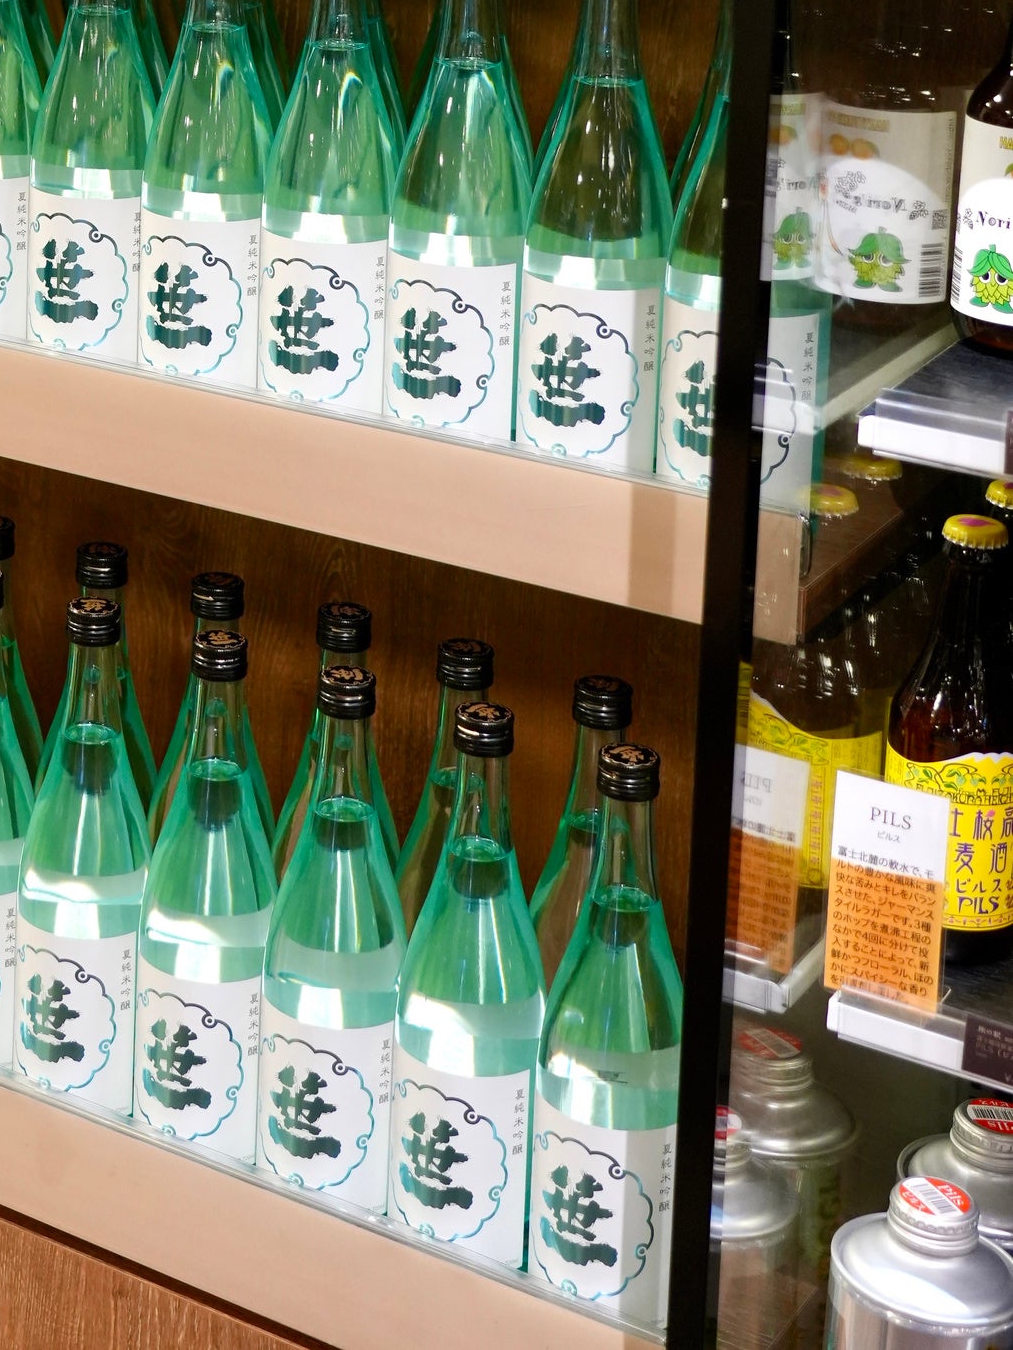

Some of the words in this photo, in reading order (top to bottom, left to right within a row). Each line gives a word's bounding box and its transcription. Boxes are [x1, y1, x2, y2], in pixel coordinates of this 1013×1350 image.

[16, 192, 28, 252] 夏純米吟醸
[247, 234, 259, 299] 夏純米吟醸
[374, 255, 386, 320] 夏純米吟醸
[499, 281, 512, 348] 夏純米吟醸
[643, 304, 659, 373] 夏純米吟醸
[870, 806, 913, 831] PILS
[877, 830, 901, 844] ピルス
[837, 860, 936, 894] ルトの豊かな風味に爽
[838, 845, 935, 880] 富士北麓の軟水で、モ
[955, 843, 1007, 875] 麦酒
[835, 885, 935, 921] スさせた、ジャーマンス
[836, 873, 937, 906] 快な苦みとキレをバラン
[956, 879, 1003, 894] ピルス
[834, 897, 933, 932] タイルラガーです。3種
[958, 896, 1000, 915] PILS
[5, 907, 16, 968] 夏純米吟醸
[832, 923, 929, 958] なかで4回に分けて投
[833, 911, 932, 945] のホップを煮沸工程の
[831, 949, 934, 986] 鮮かつフローラル、ほの
[832, 936, 930, 972] 入することによって、新
[120, 948, 132, 1011] 夏純米吟醸
[830, 962, 928, 997] かにスパイシーな香り
[247, 993, 260, 1057] 夏純米吟醸
[378, 1038, 392, 1106] 夏純米吟醸
[511, 1087, 525, 1156] 夏純米吟醸
[658, 1142, 673, 1213] 夏純米吟醸
[937, 1184, 965, 1208] Pils
